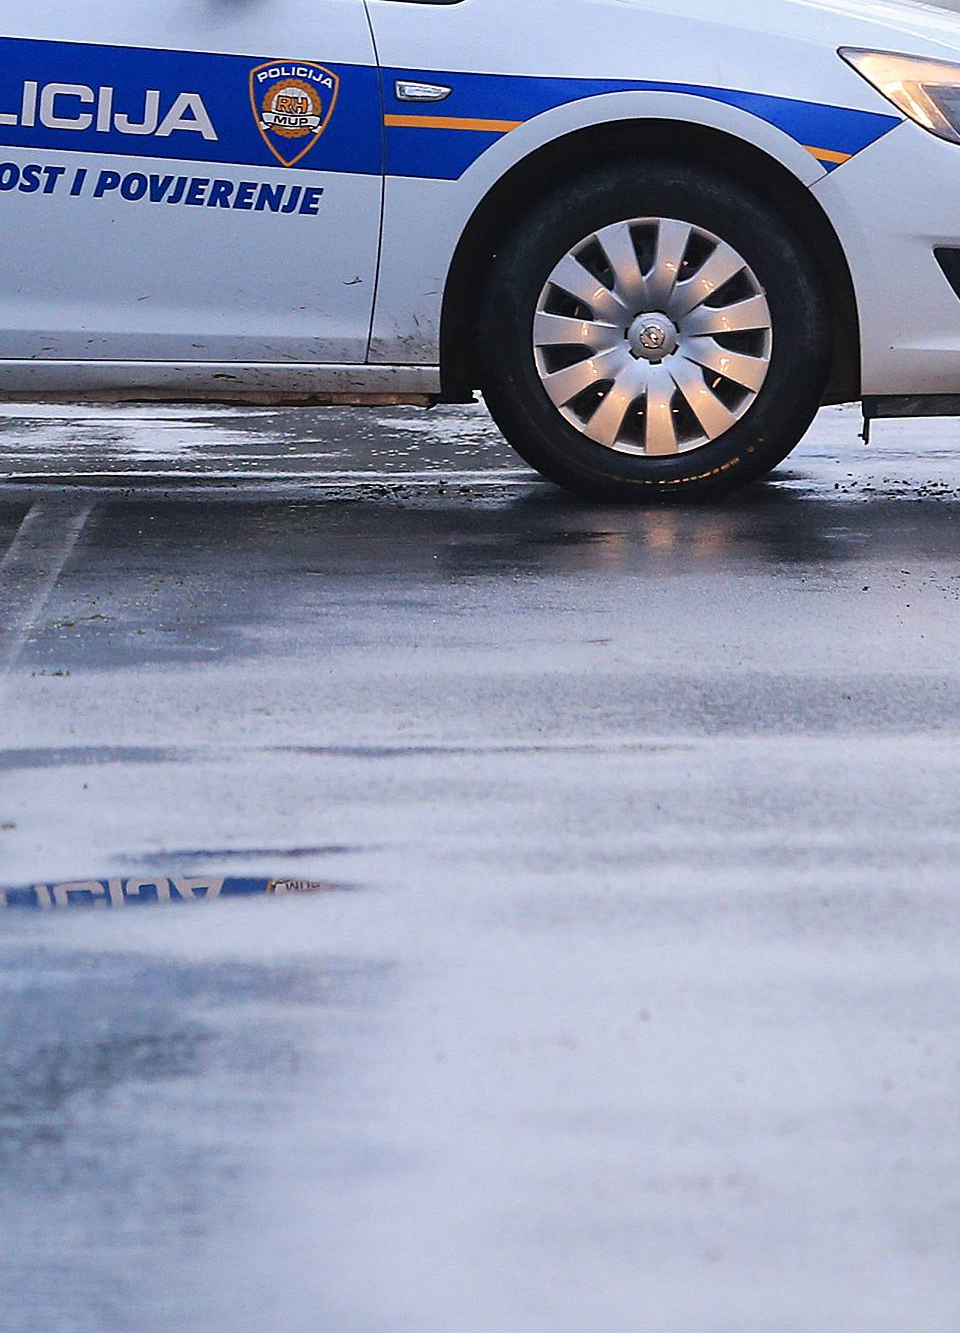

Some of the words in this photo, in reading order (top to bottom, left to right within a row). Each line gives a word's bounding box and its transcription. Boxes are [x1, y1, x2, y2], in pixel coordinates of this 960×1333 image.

[257, 67, 333, 88] POLICIJA
[277, 96, 309, 114] RH
[274, 116, 309, 126] MUP
[70, 168, 87, 197] I
[94, 170, 324, 215] POVJERENJE
